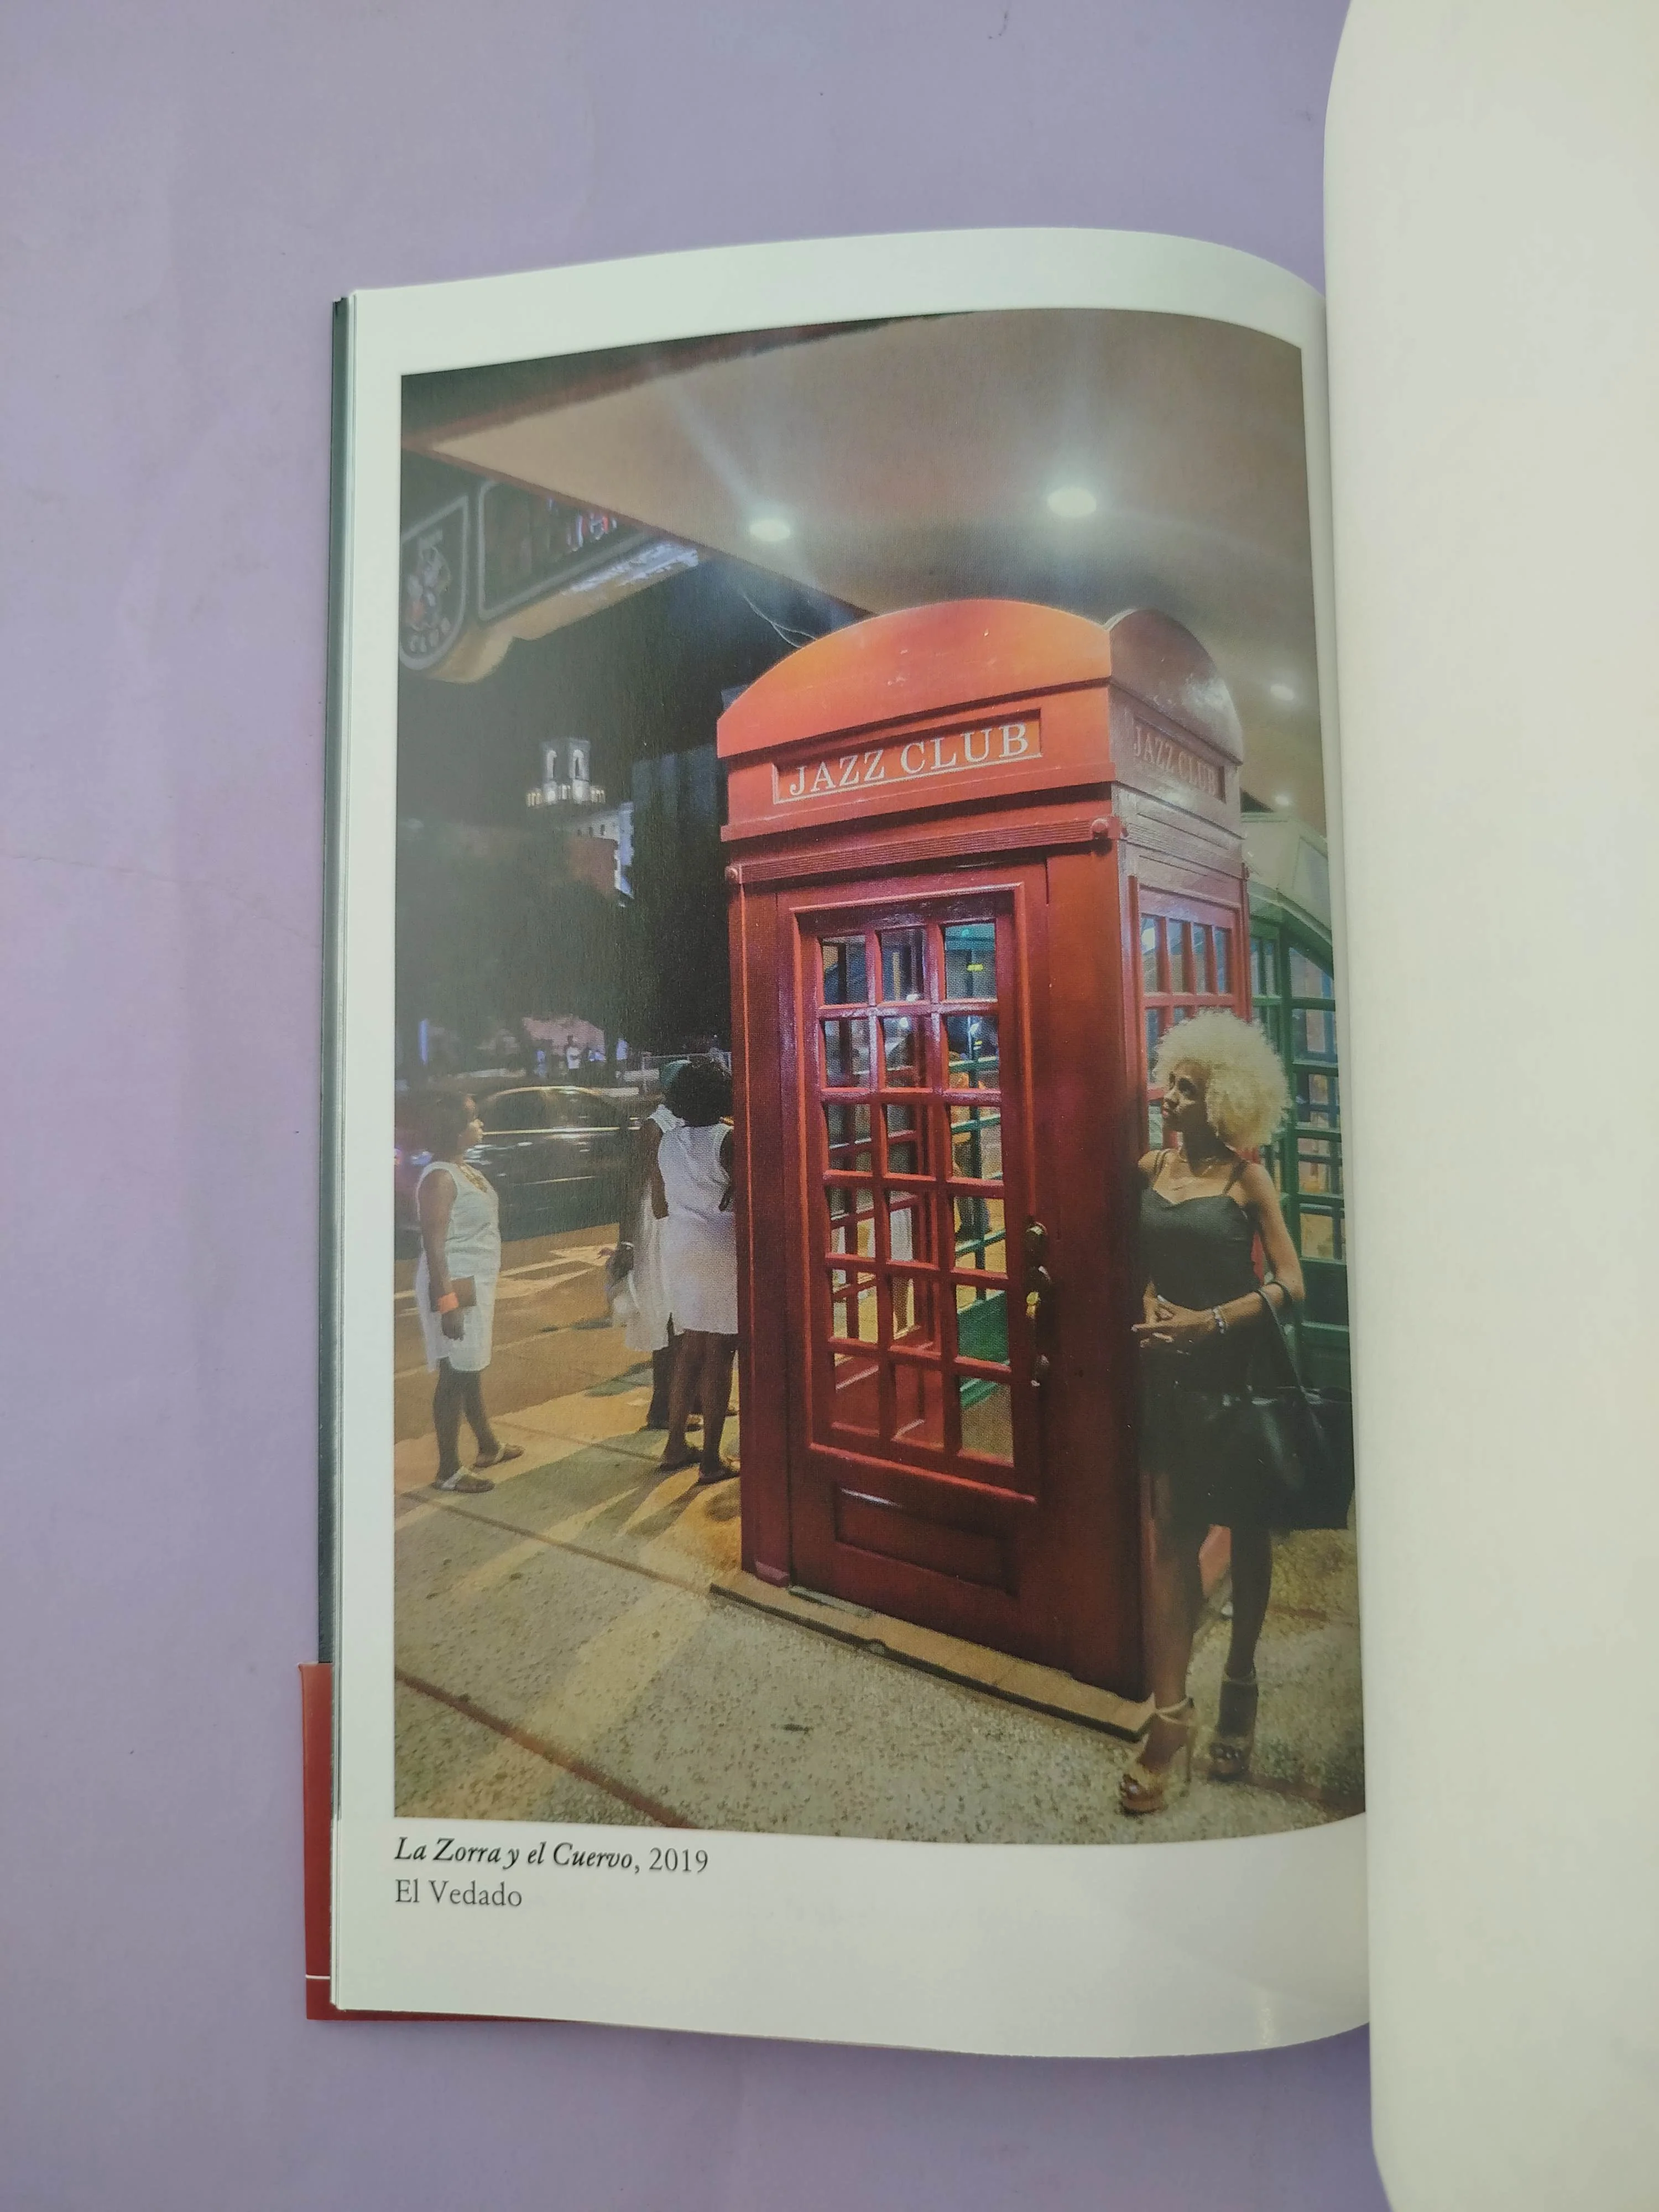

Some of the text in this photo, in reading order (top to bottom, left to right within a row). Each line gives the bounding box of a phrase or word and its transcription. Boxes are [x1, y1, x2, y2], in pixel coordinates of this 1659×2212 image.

[789, 721, 1029, 796] JAZZ CLUB
[1133, 725, 1175, 774] JAZZ
[394, 1836, 709, 1874] La Zorra y el Cuervo, 2019
[395, 1878, 523, 1908] El Vedado
